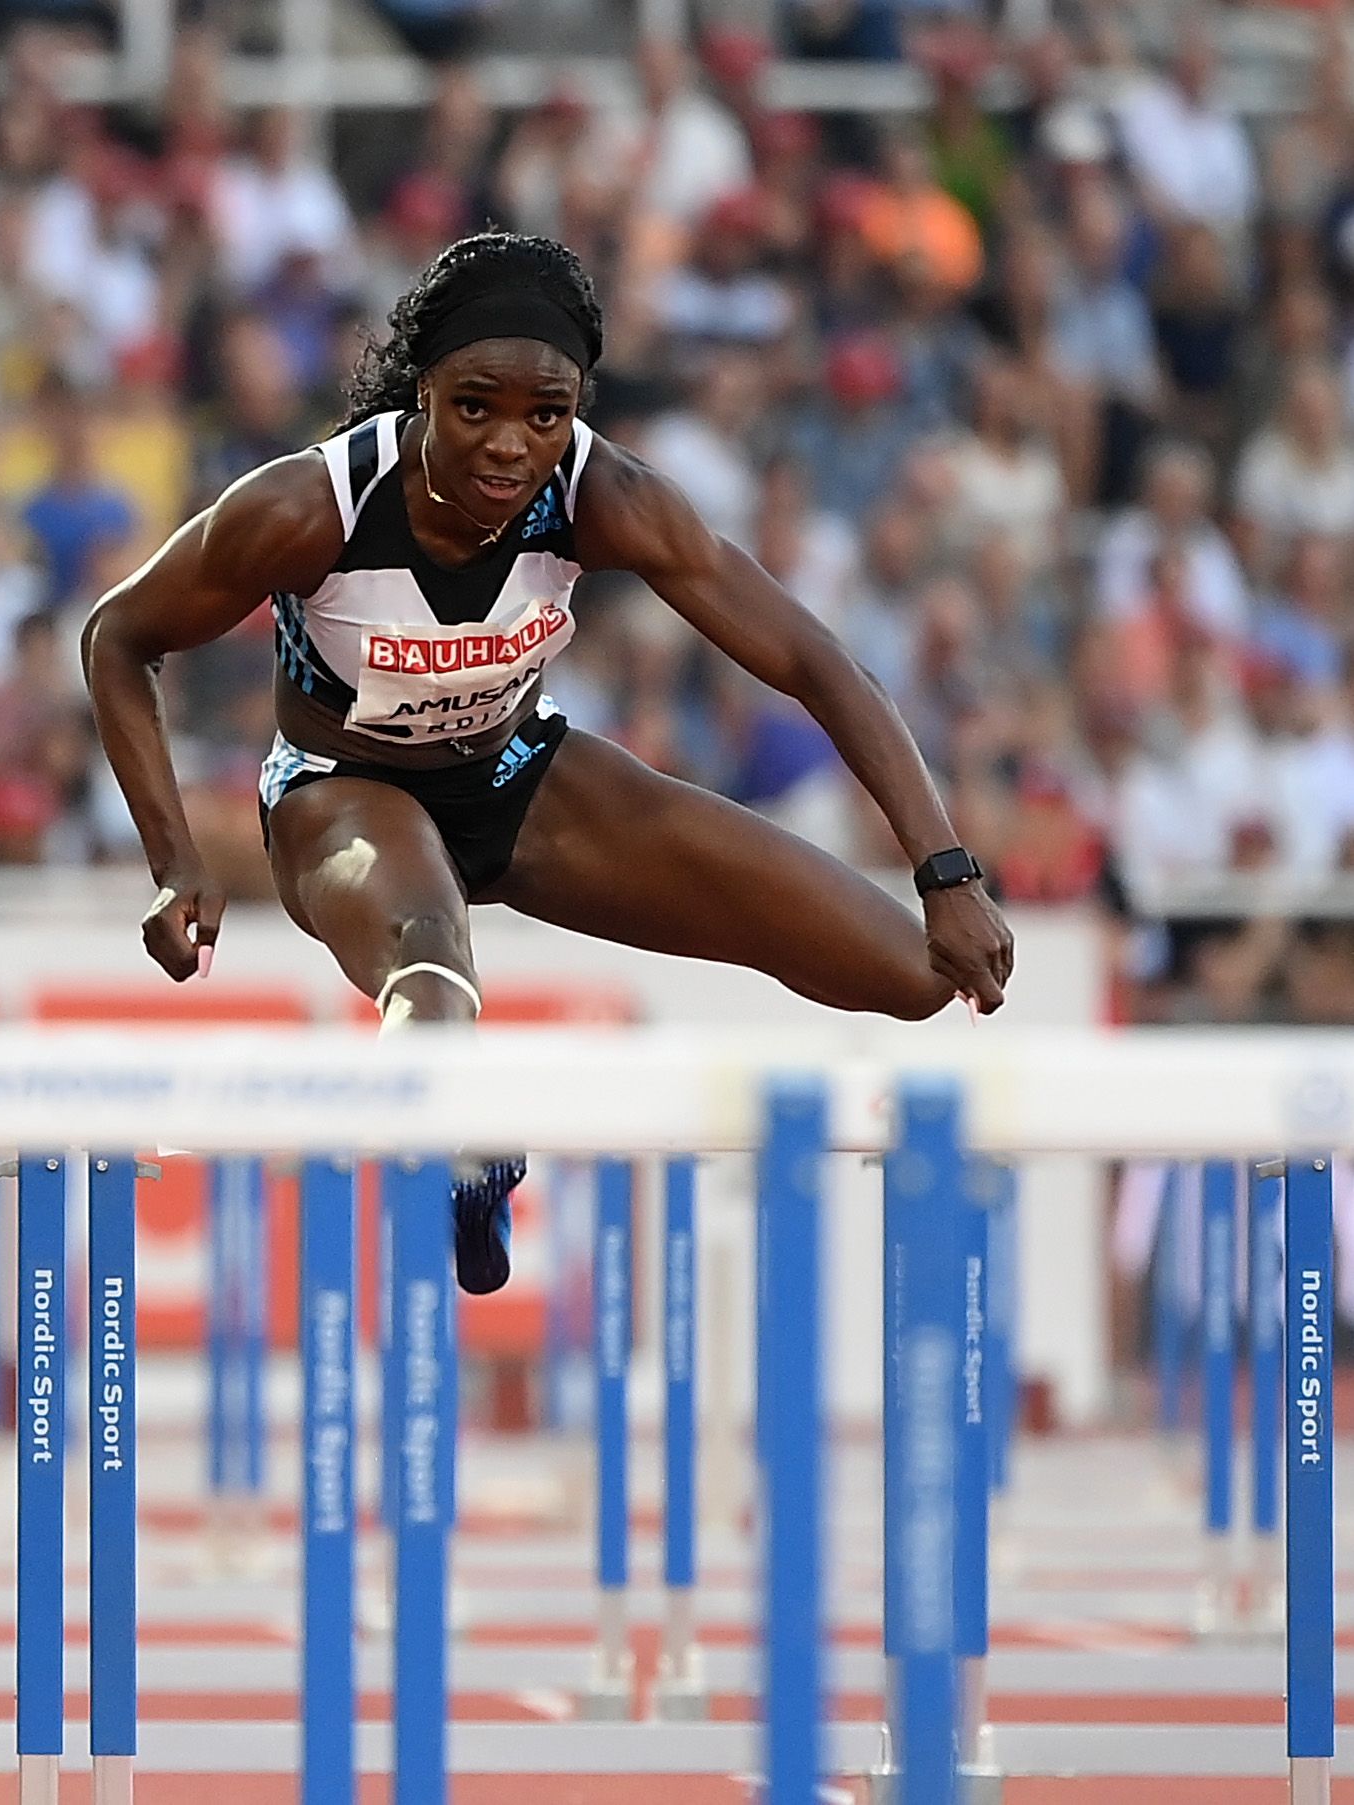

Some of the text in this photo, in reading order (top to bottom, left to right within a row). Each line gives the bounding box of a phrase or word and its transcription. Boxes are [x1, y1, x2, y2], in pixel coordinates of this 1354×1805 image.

[371, 604, 565, 671] BAUHAUS
[389, 657, 546, 719] AMUSAN
[28, 1376, 52, 1463] Sport
[99, 1384, 123, 1471] Sport
[1297, 1378, 1321, 1465] Sport
